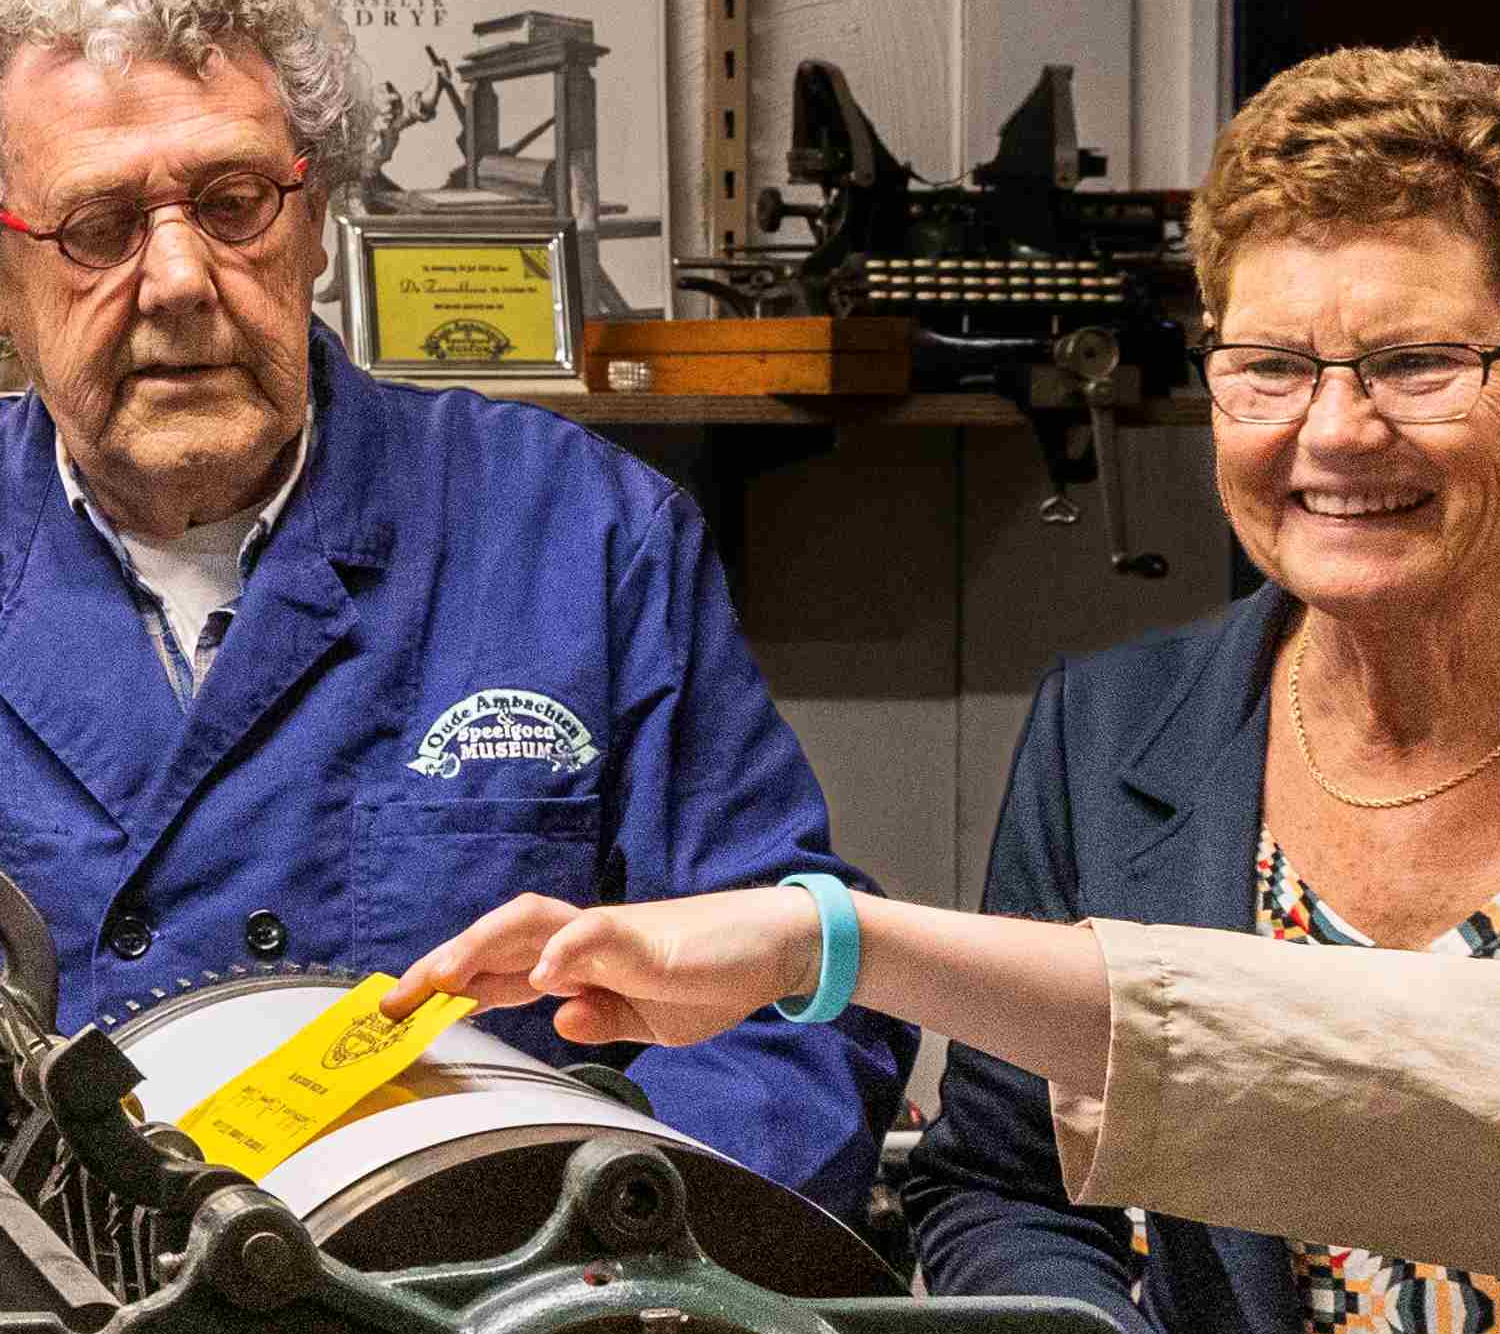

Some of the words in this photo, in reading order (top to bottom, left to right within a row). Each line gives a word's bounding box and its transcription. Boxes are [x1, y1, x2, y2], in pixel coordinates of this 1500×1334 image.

[335, 9, 449, 27] DRYF
[427, 707, 473, 749] Oude
[475, 694, 582, 741] Ambachten
[460, 740, 554, 761] MUSEUM
